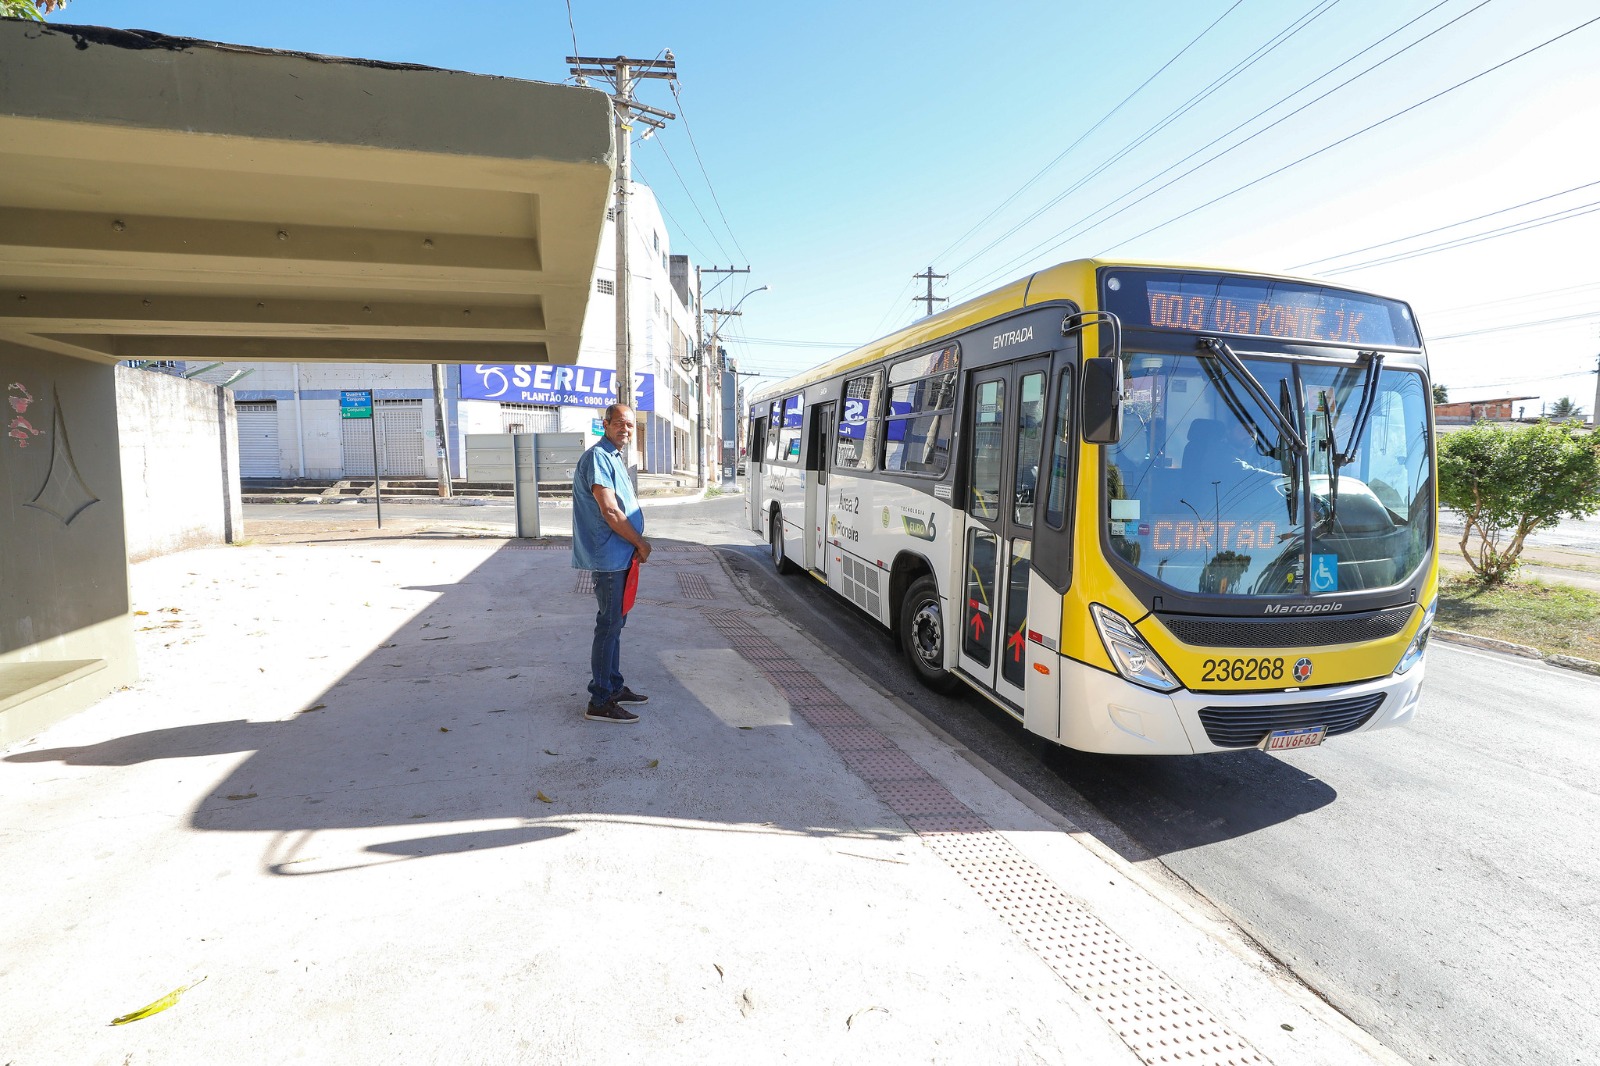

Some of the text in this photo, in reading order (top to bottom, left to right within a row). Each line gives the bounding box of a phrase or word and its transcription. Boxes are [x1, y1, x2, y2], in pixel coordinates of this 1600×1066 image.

[1215, 299, 1250, 334] Via
[1254, 303, 1326, 340] PONTE
[992, 325, 1033, 350] ENTRADA
[521, 391, 562, 402] PLANTÃO
[563, 394, 578, 404] 24h
[584, 396, 602, 405] 0800
[838, 488, 859, 515] Área 2
[837, 520, 859, 543] Pioneira
[909, 512, 937, 543] EURO 6
[1153, 521, 1276, 550] CARTÃO
[1263, 601, 1343, 614] Marcopolo
[1201, 657, 1284, 682] 236268
[1271, 733, 1318, 749] UIV6F62
